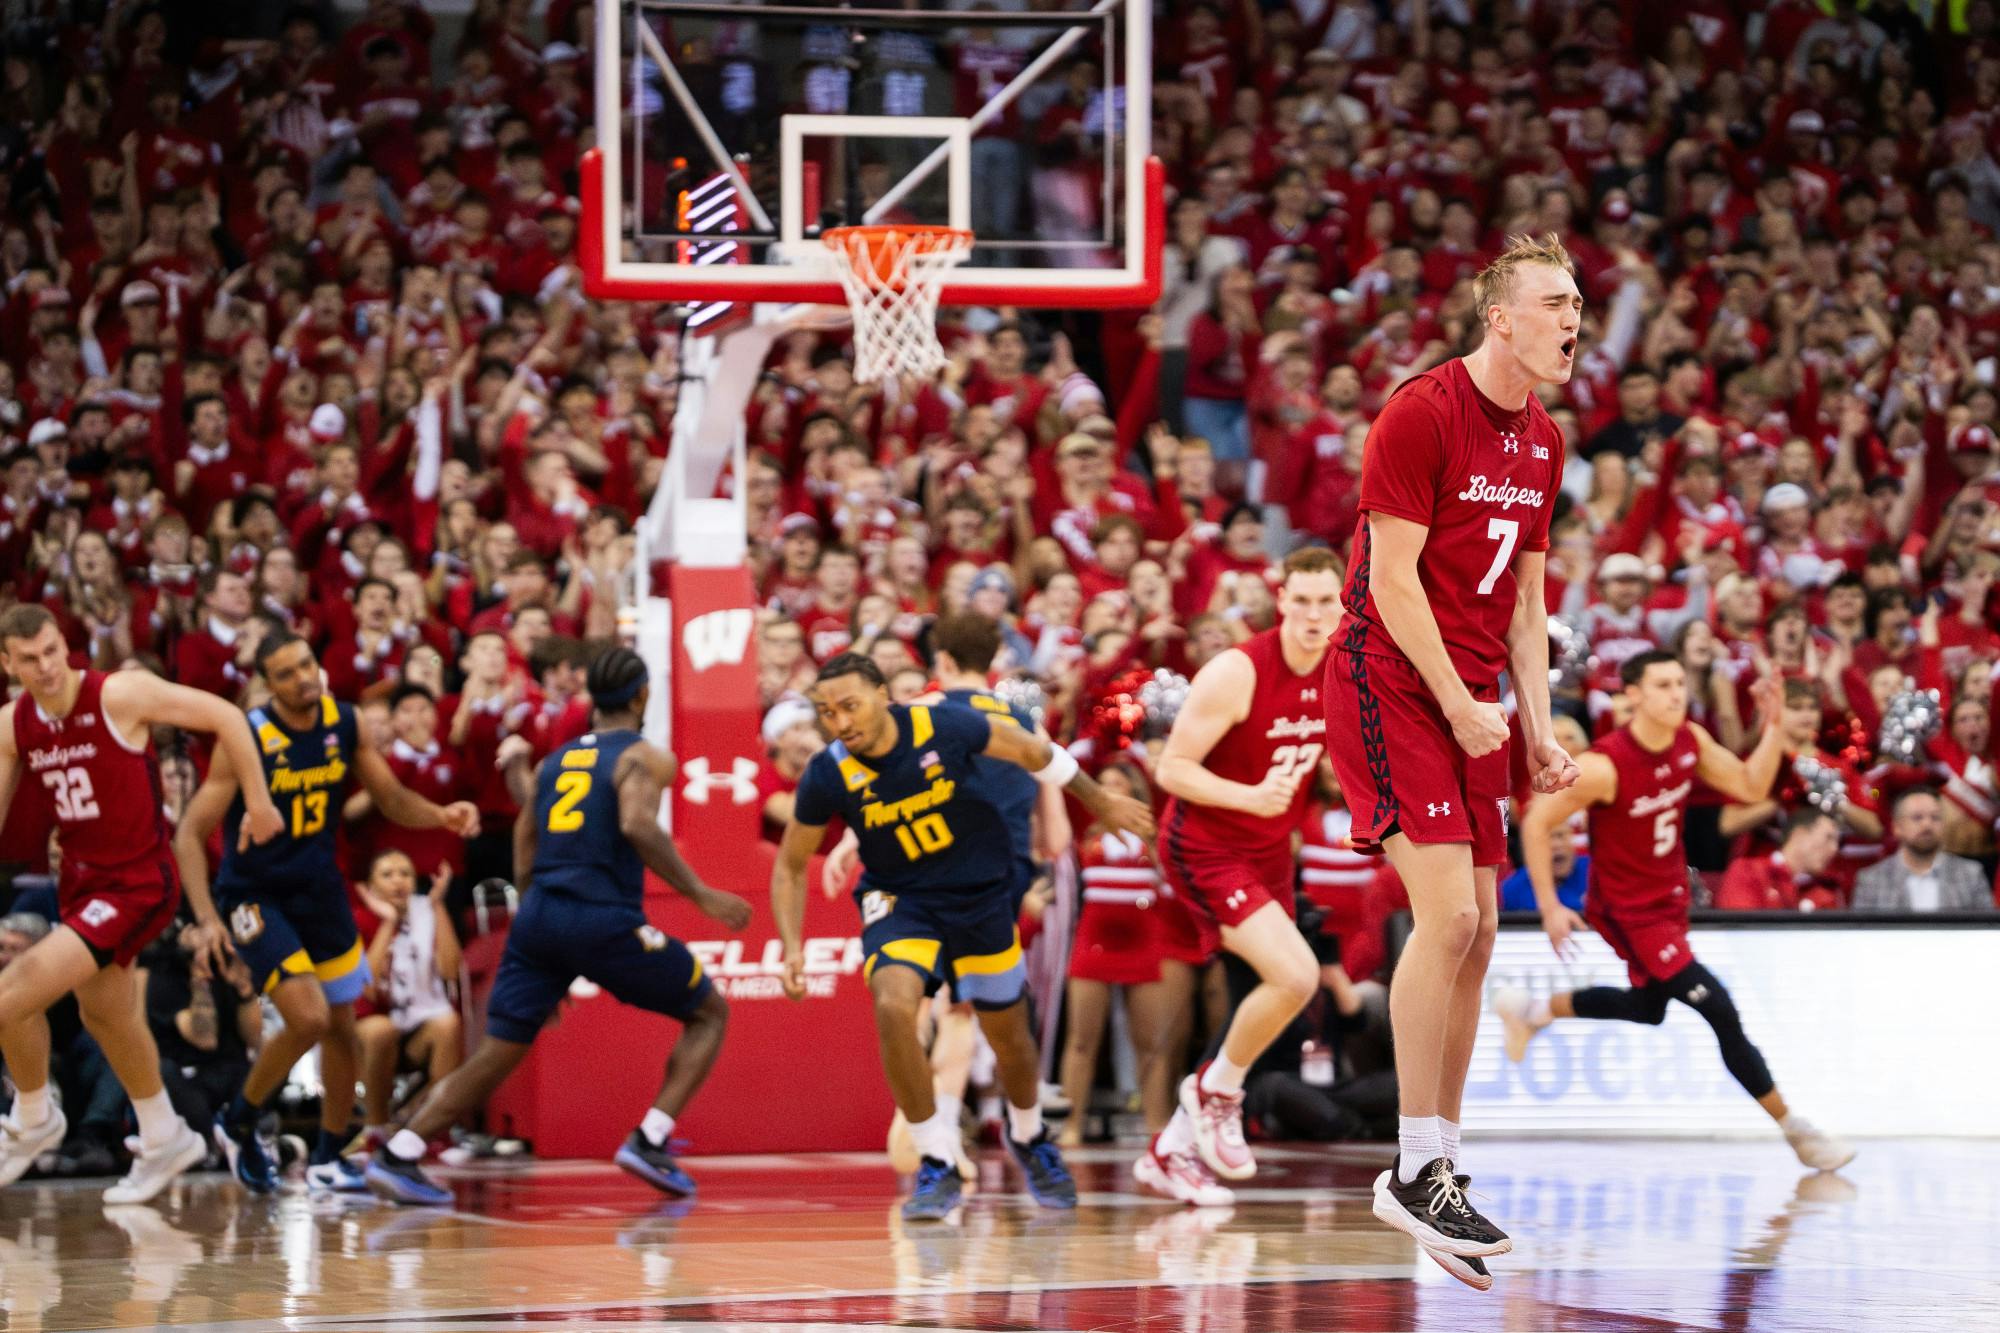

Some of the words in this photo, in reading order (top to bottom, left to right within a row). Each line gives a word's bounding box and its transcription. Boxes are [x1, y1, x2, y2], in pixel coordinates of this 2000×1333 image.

[1458, 474, 1544, 511] Badgers
[1476, 517, 1520, 595] 7
[682, 608, 754, 672] W
[41, 766, 101, 821] 32
[291, 790, 330, 838] 13
[547, 770, 593, 834] 2
[894, 812, 955, 862] 10
[1652, 807, 1679, 858] 5
